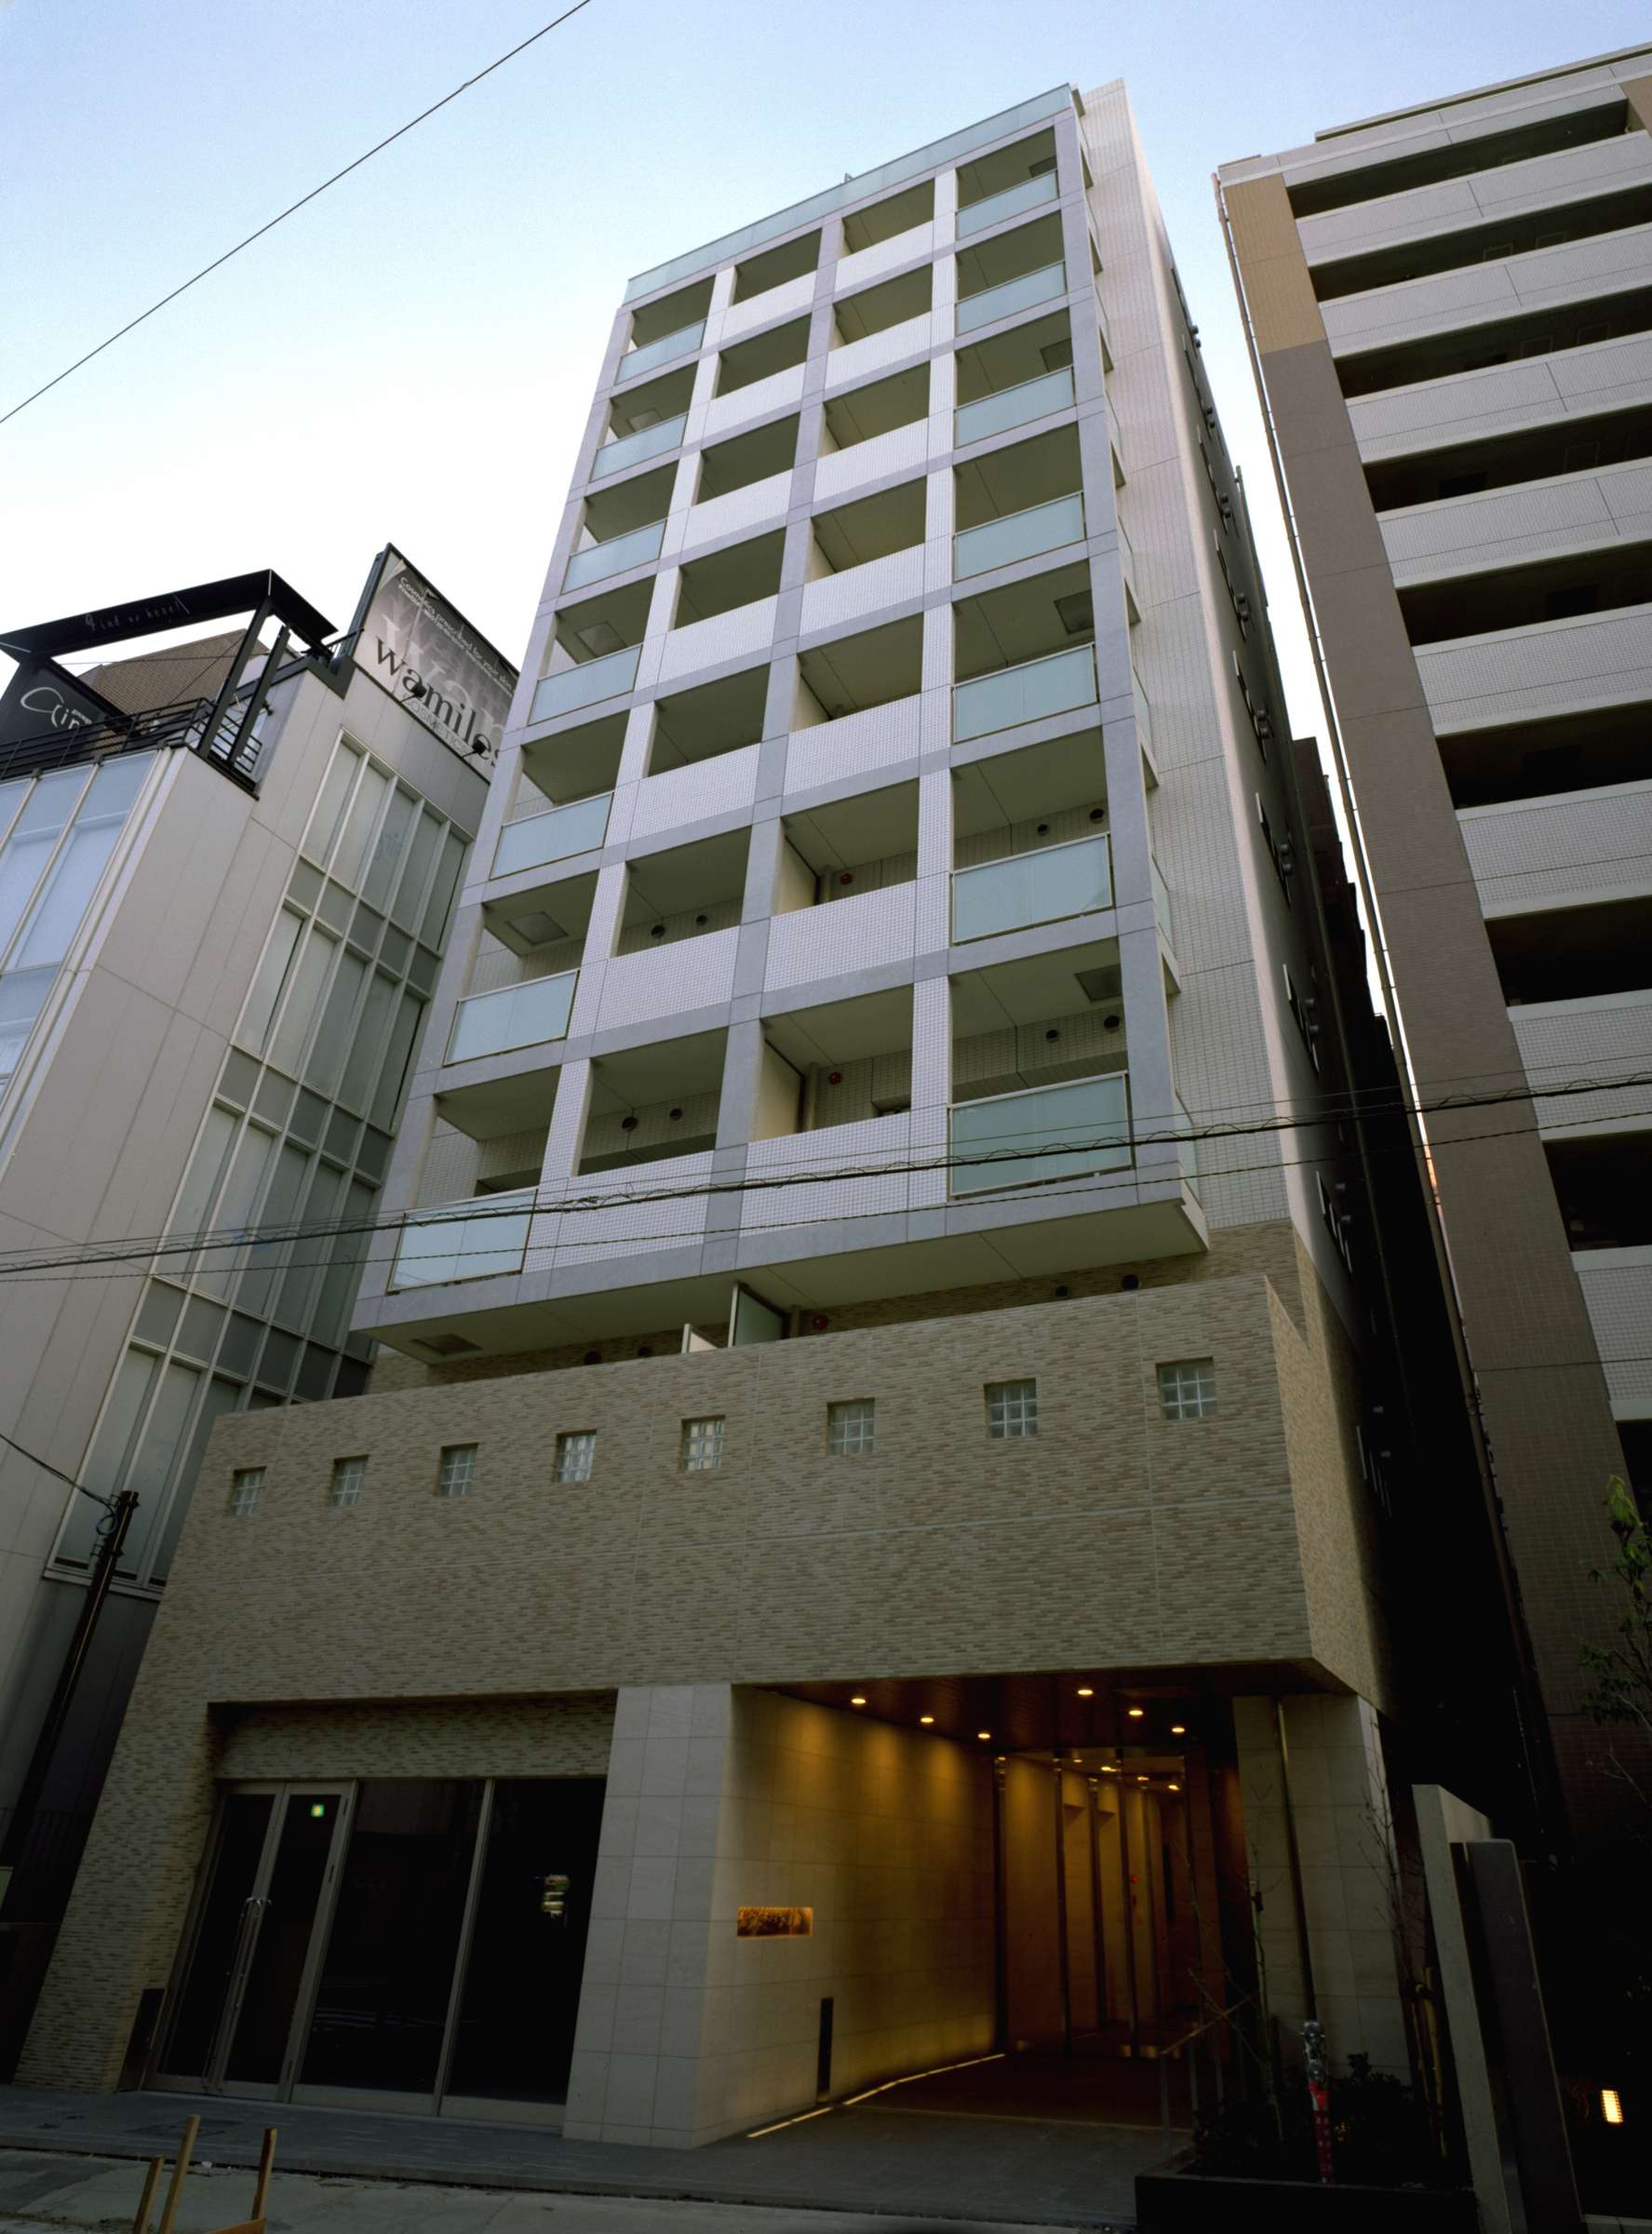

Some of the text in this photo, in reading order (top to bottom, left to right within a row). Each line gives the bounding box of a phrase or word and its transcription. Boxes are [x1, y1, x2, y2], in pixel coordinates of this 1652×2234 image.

[400, 577, 513, 690] Cosmetics prescribed for your skin
[402, 693, 469, 755] COSMETICS
